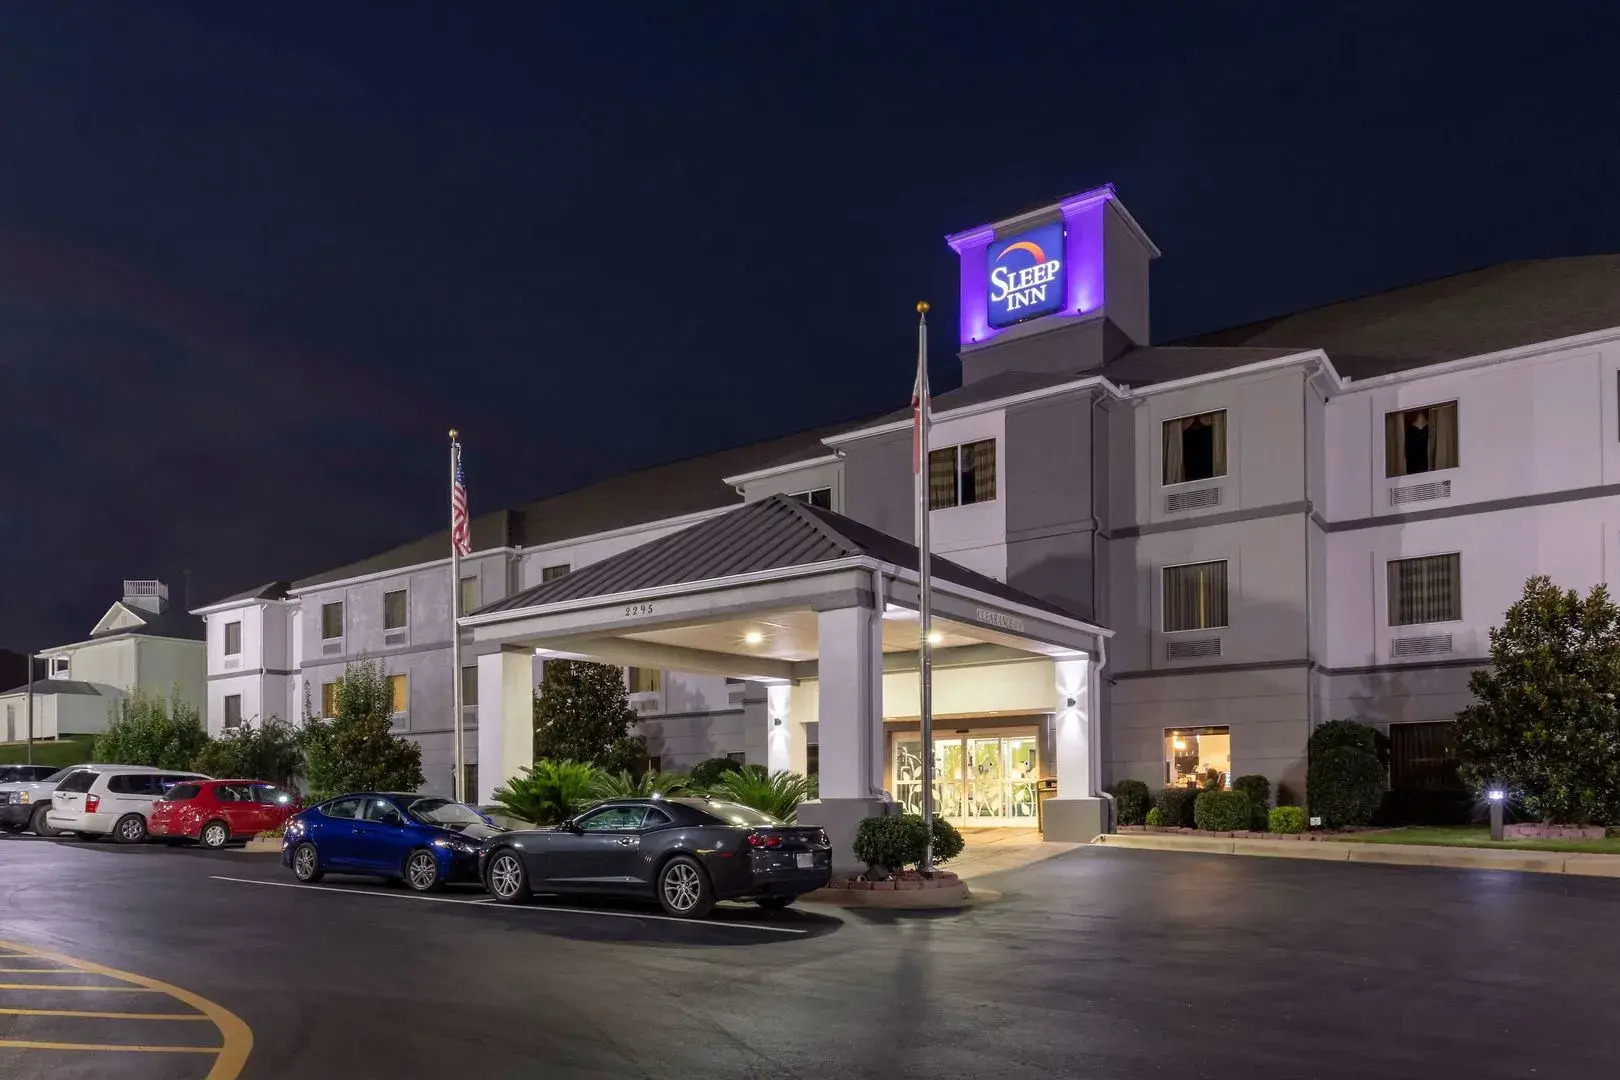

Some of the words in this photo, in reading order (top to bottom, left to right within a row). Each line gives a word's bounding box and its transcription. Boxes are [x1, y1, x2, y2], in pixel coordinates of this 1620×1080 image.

[991, 260, 1060, 302] SLEEP
[1006, 285, 1047, 311] INN
[625, 604, 653, 616] 2295
